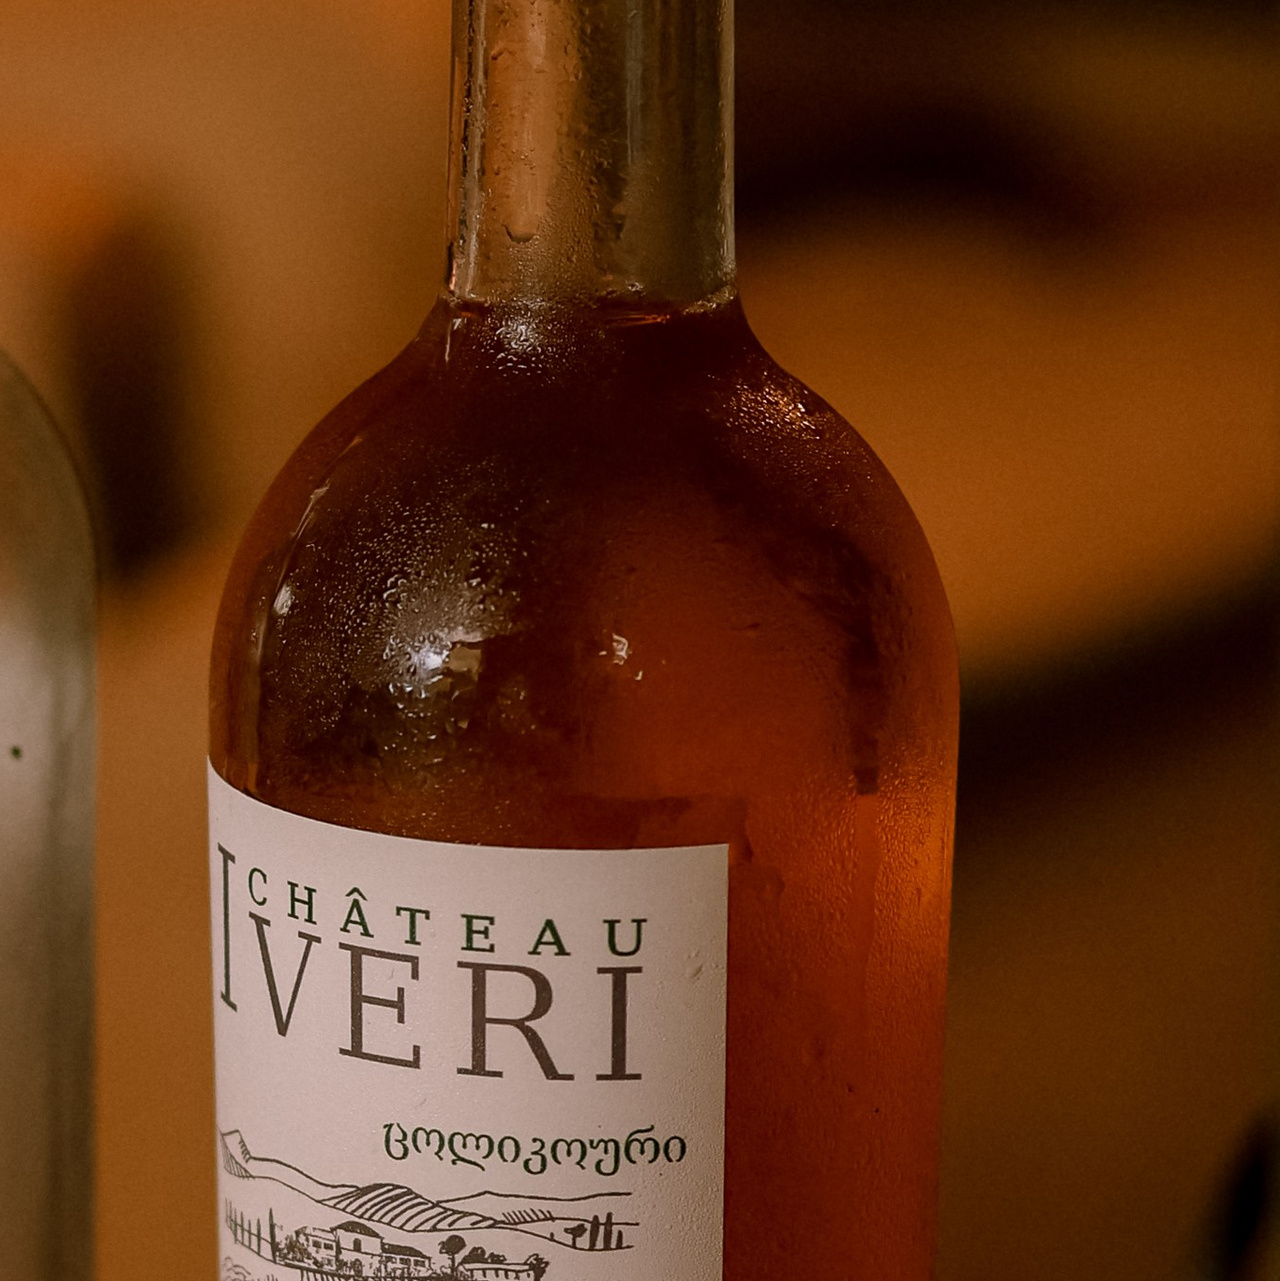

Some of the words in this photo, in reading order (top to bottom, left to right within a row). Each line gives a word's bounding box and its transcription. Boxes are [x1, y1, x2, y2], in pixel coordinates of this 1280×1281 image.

[248, 867, 647, 957] CHÂTEAU
[217, 842, 643, 1082] IVERI
[383, 1122, 687, 1177] ცოლიკოური
